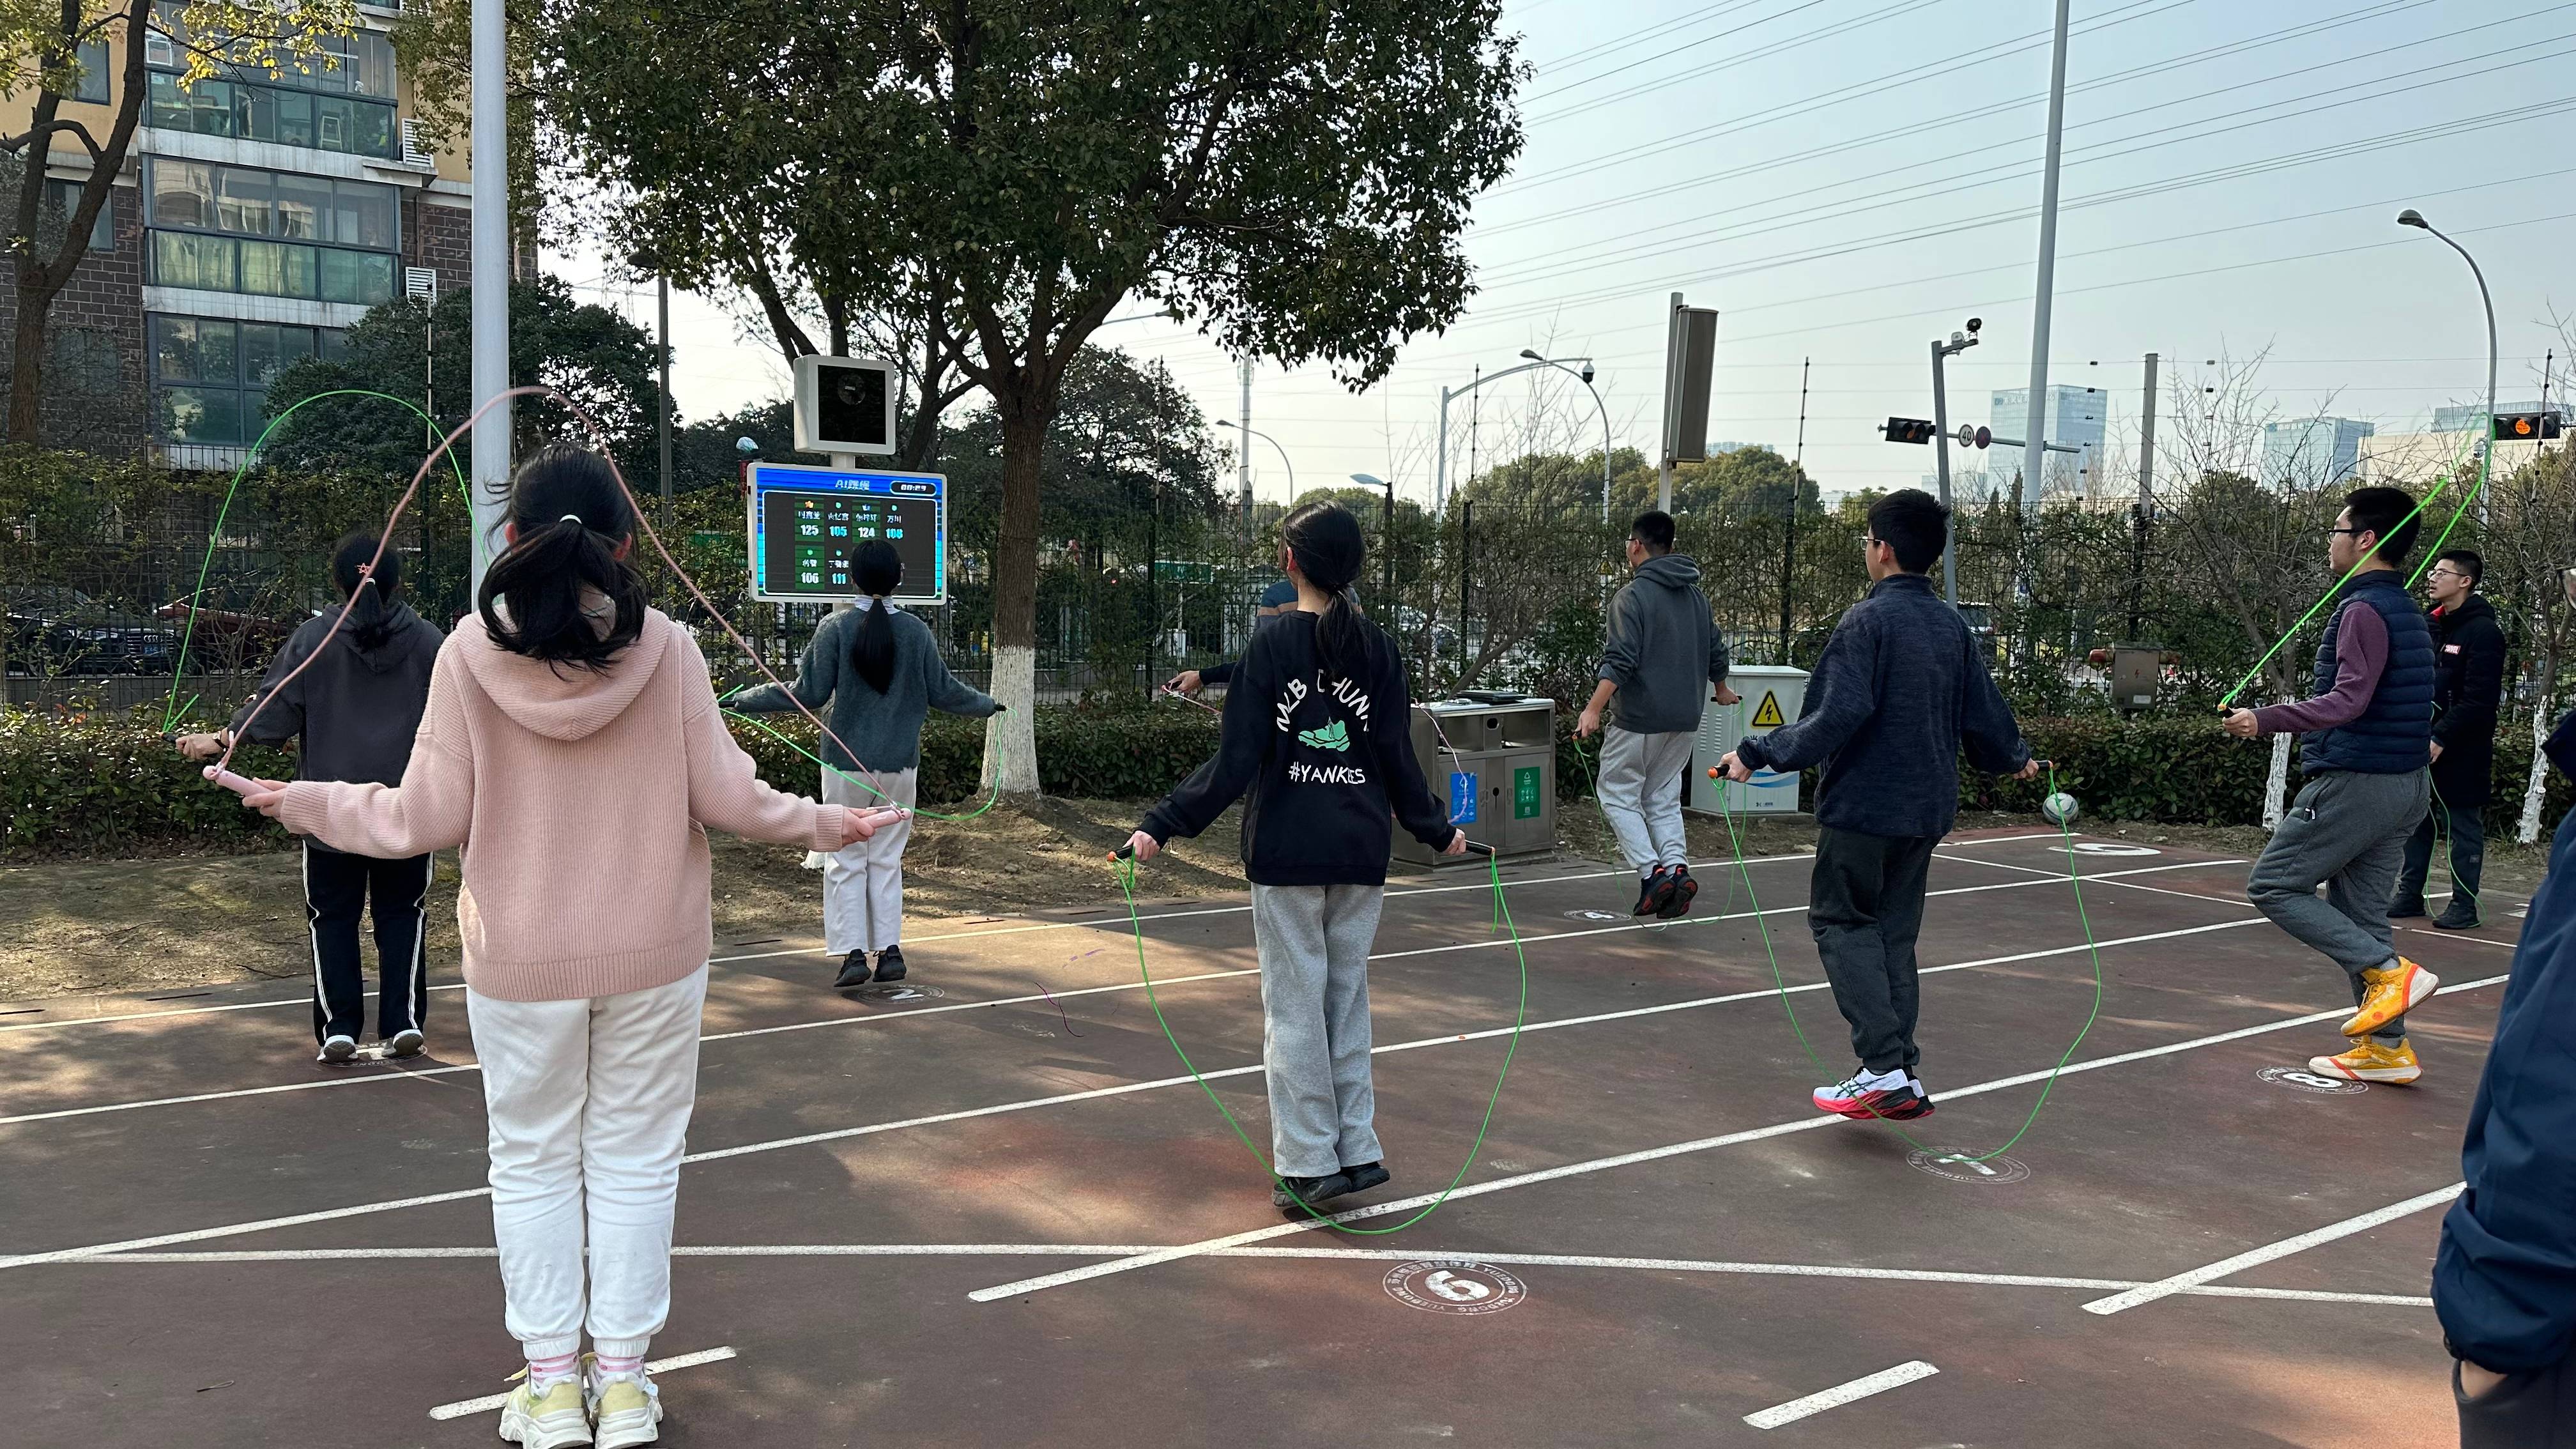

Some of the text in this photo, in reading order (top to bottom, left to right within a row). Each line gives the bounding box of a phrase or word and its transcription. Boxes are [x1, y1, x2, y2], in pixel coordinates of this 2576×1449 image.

[1962, 431, 1972, 441] 40
[800, 525, 819, 537] 125
[857, 527, 875, 538] 124
[801, 572, 819, 584] 106
[832, 573, 847, 585] 111
[1276, 678, 1307, 732] MLB
[882, 988, 925, 1001] 2
[2282, 1072, 2343, 1088] 8
[1424, 1269, 1491, 1301] 6
